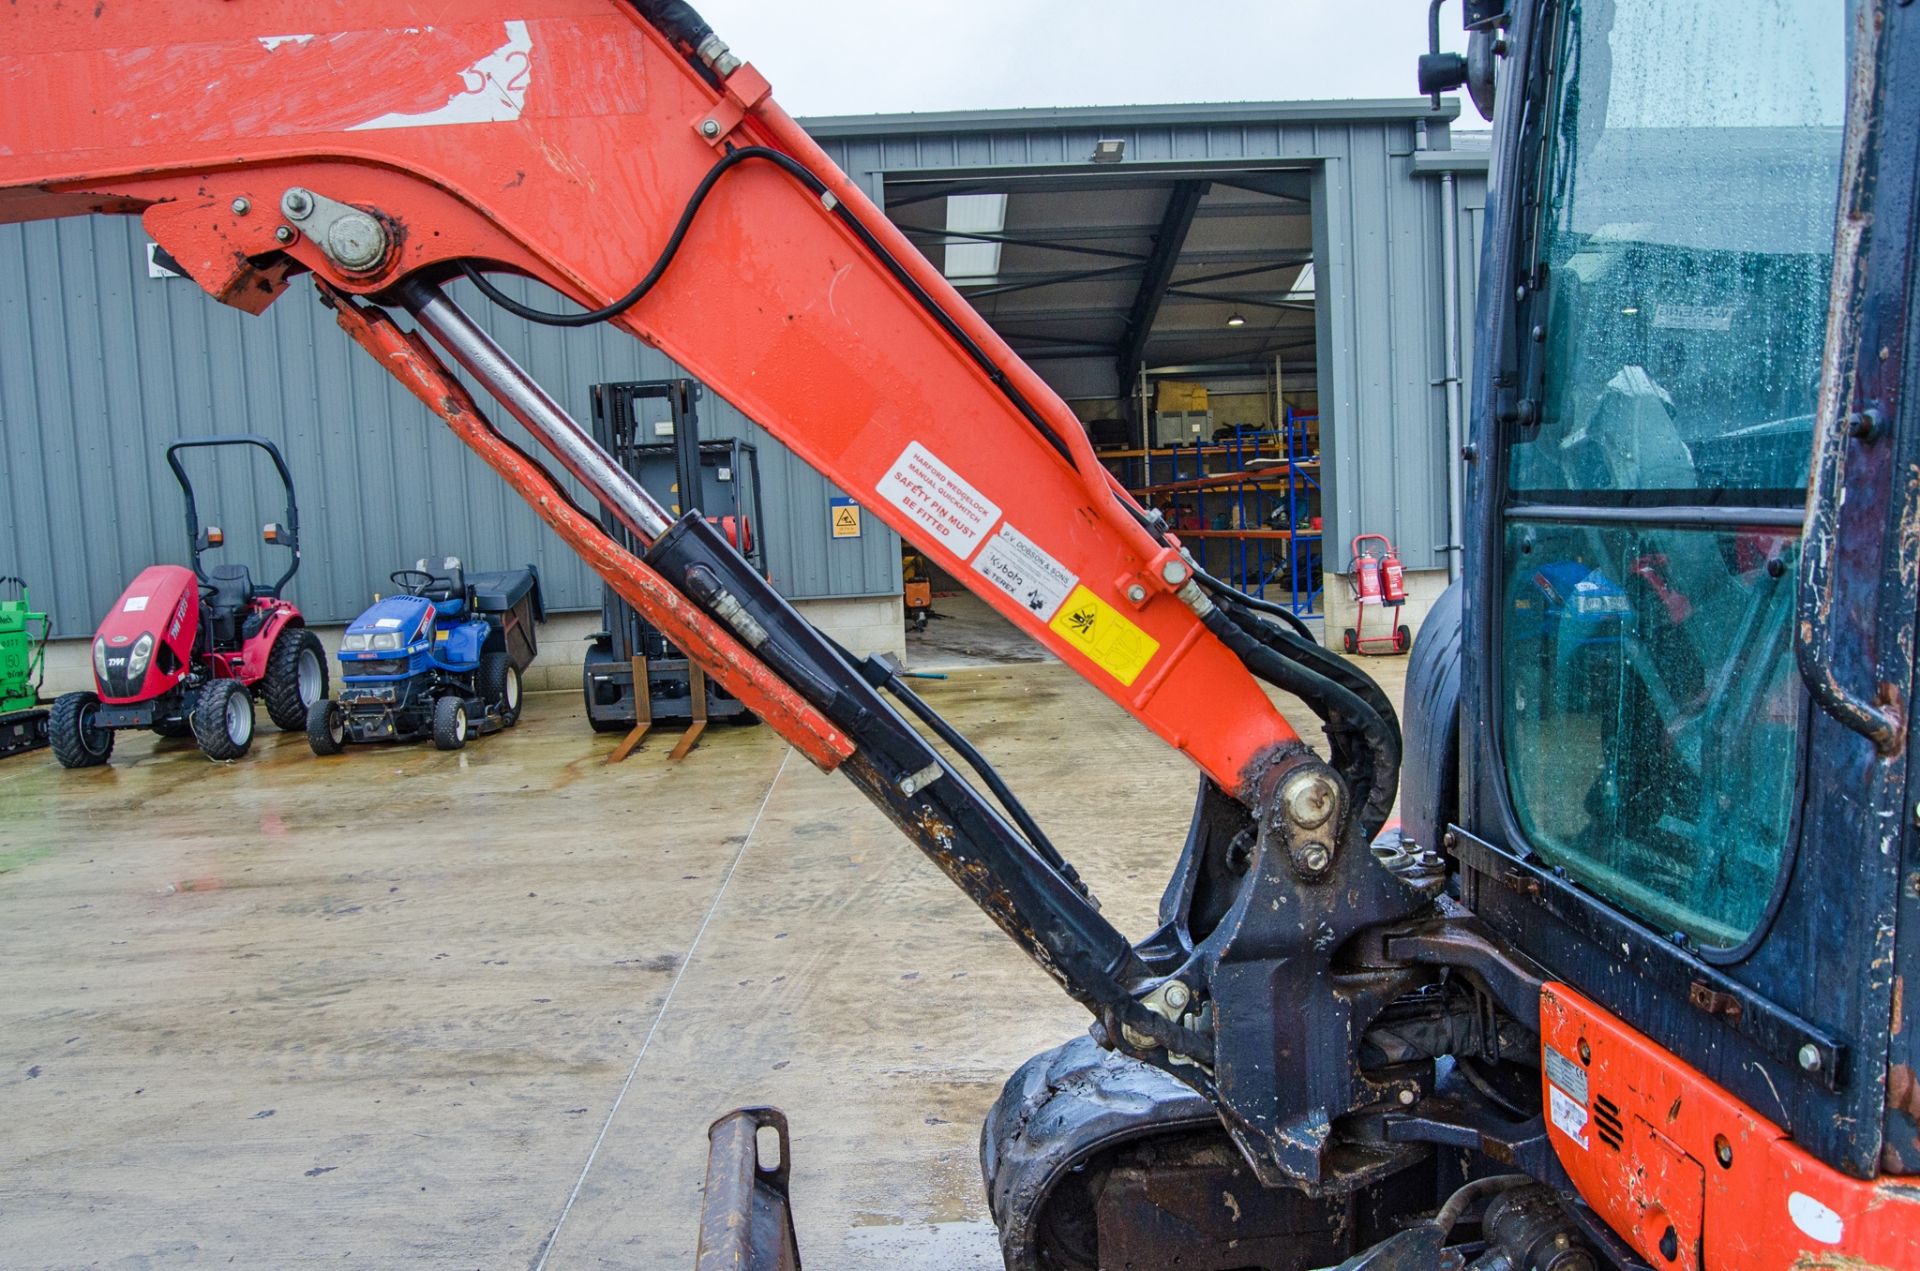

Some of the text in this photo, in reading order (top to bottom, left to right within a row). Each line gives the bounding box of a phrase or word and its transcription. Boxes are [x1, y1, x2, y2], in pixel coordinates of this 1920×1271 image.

[894, 471, 977, 539] SAFETY PIN MUST
[908, 463, 981, 524] MANUAL QUICKHITCH
[913, 453, 989, 517] HARFORD WEDGELOCK
[902, 496, 950, 536] BE FITTED
[1016, 540, 1044, 565] DOBSON
[1050, 566, 1070, 585] SONS
